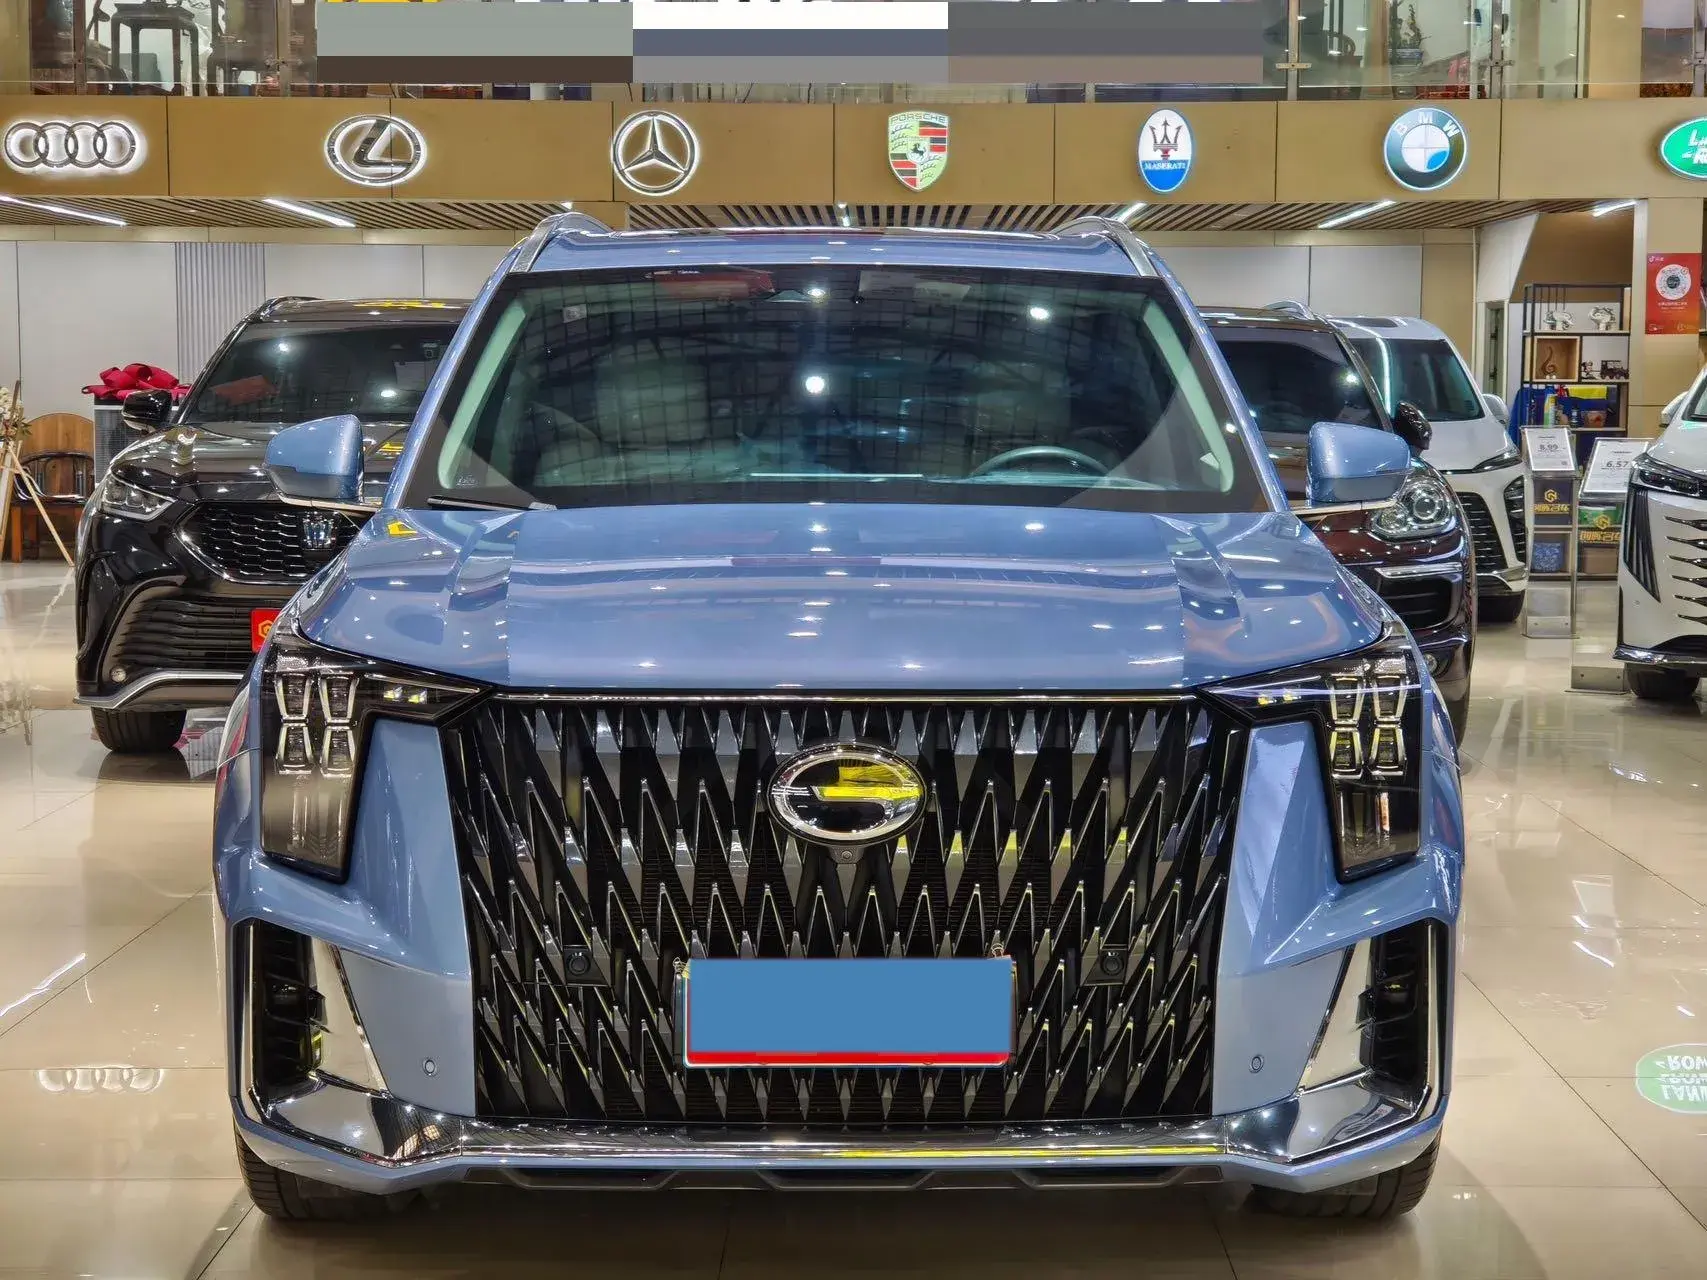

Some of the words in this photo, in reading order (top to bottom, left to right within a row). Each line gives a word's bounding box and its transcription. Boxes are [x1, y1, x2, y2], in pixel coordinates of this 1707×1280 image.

[890, 112, 946, 124] PORSCHE
[1394, 110, 1461, 138] BMW
[1144, 162, 1187, 170] MASERATI
[1606, 460, 1629, 468] 6.57
